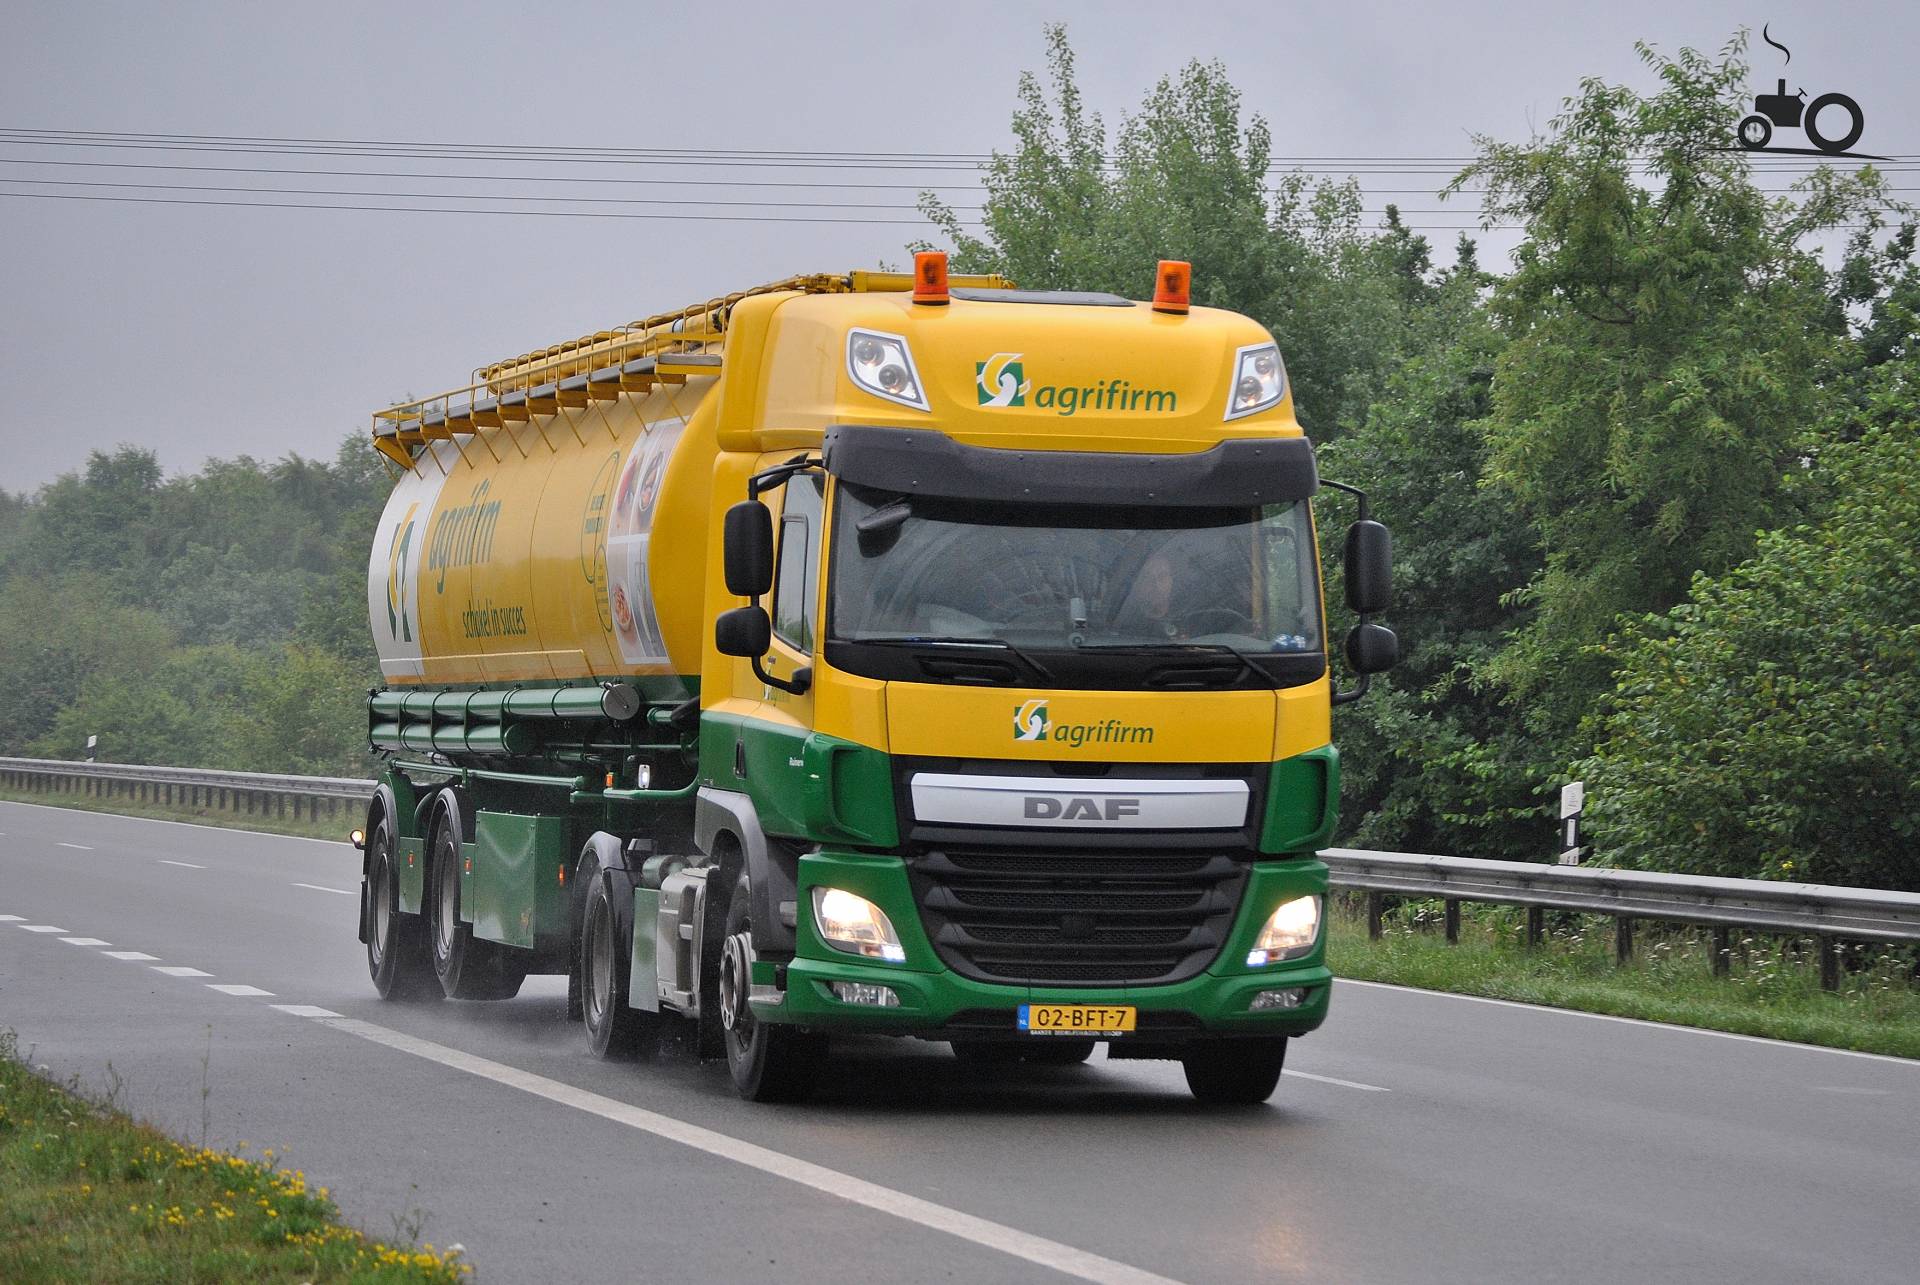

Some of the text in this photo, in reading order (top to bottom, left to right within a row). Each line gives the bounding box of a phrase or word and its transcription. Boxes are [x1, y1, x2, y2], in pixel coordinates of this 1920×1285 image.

[1034, 379, 1177, 416] agrifirm
[428, 478, 501, 594] agrifirm
[500, 606, 527, 635] succes
[1053, 719, 1154, 748] agrifirm
[1024, 797, 1140, 821] DAF
[1037, 1009, 1127, 1027] 02-BFT-7
